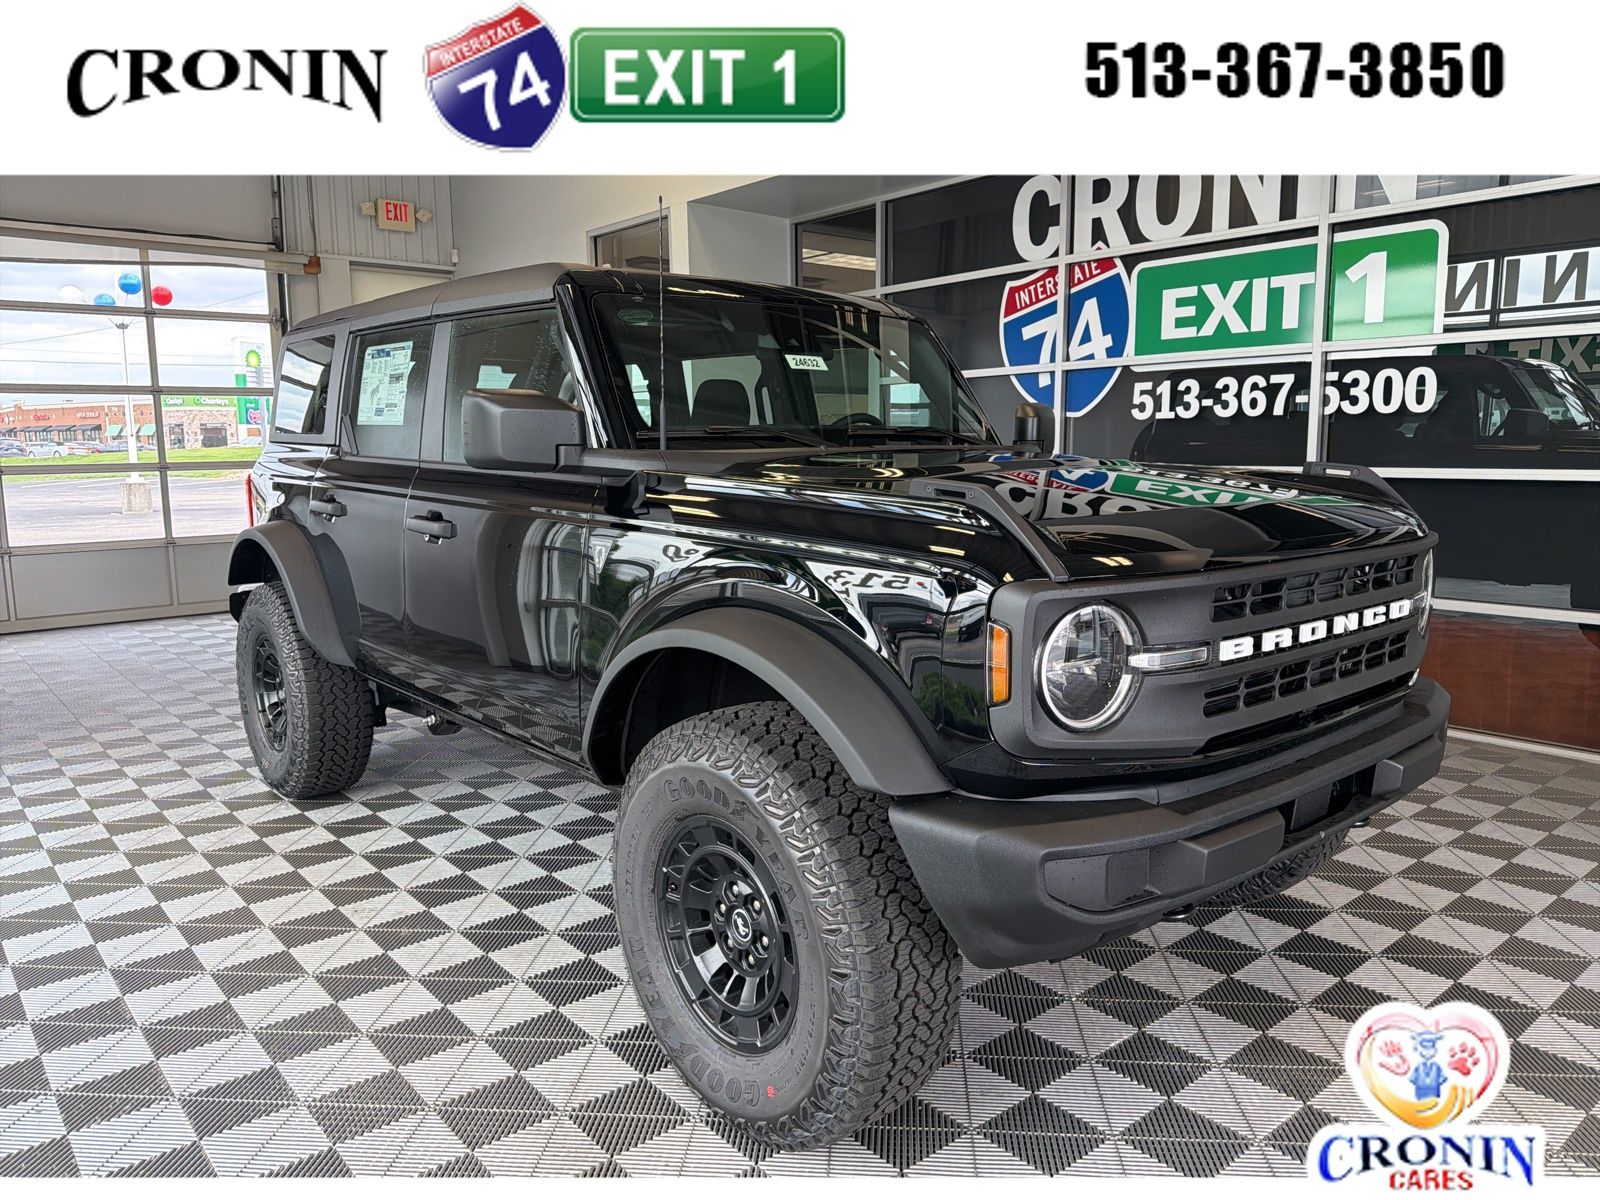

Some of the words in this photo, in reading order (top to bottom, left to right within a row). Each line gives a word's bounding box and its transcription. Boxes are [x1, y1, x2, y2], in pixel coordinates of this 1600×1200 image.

[385, 201, 408, 223] EXIT
[1015, 258, 1102, 310] INTERSATE
[1160, 272, 1315, 341] EXIT
[1345, 251, 1388, 324] 1
[1022, 297, 1113, 388] 74
[1131, 366, 1438, 421] 513-367-5300
[1219, 600, 1411, 661] BRONCO
